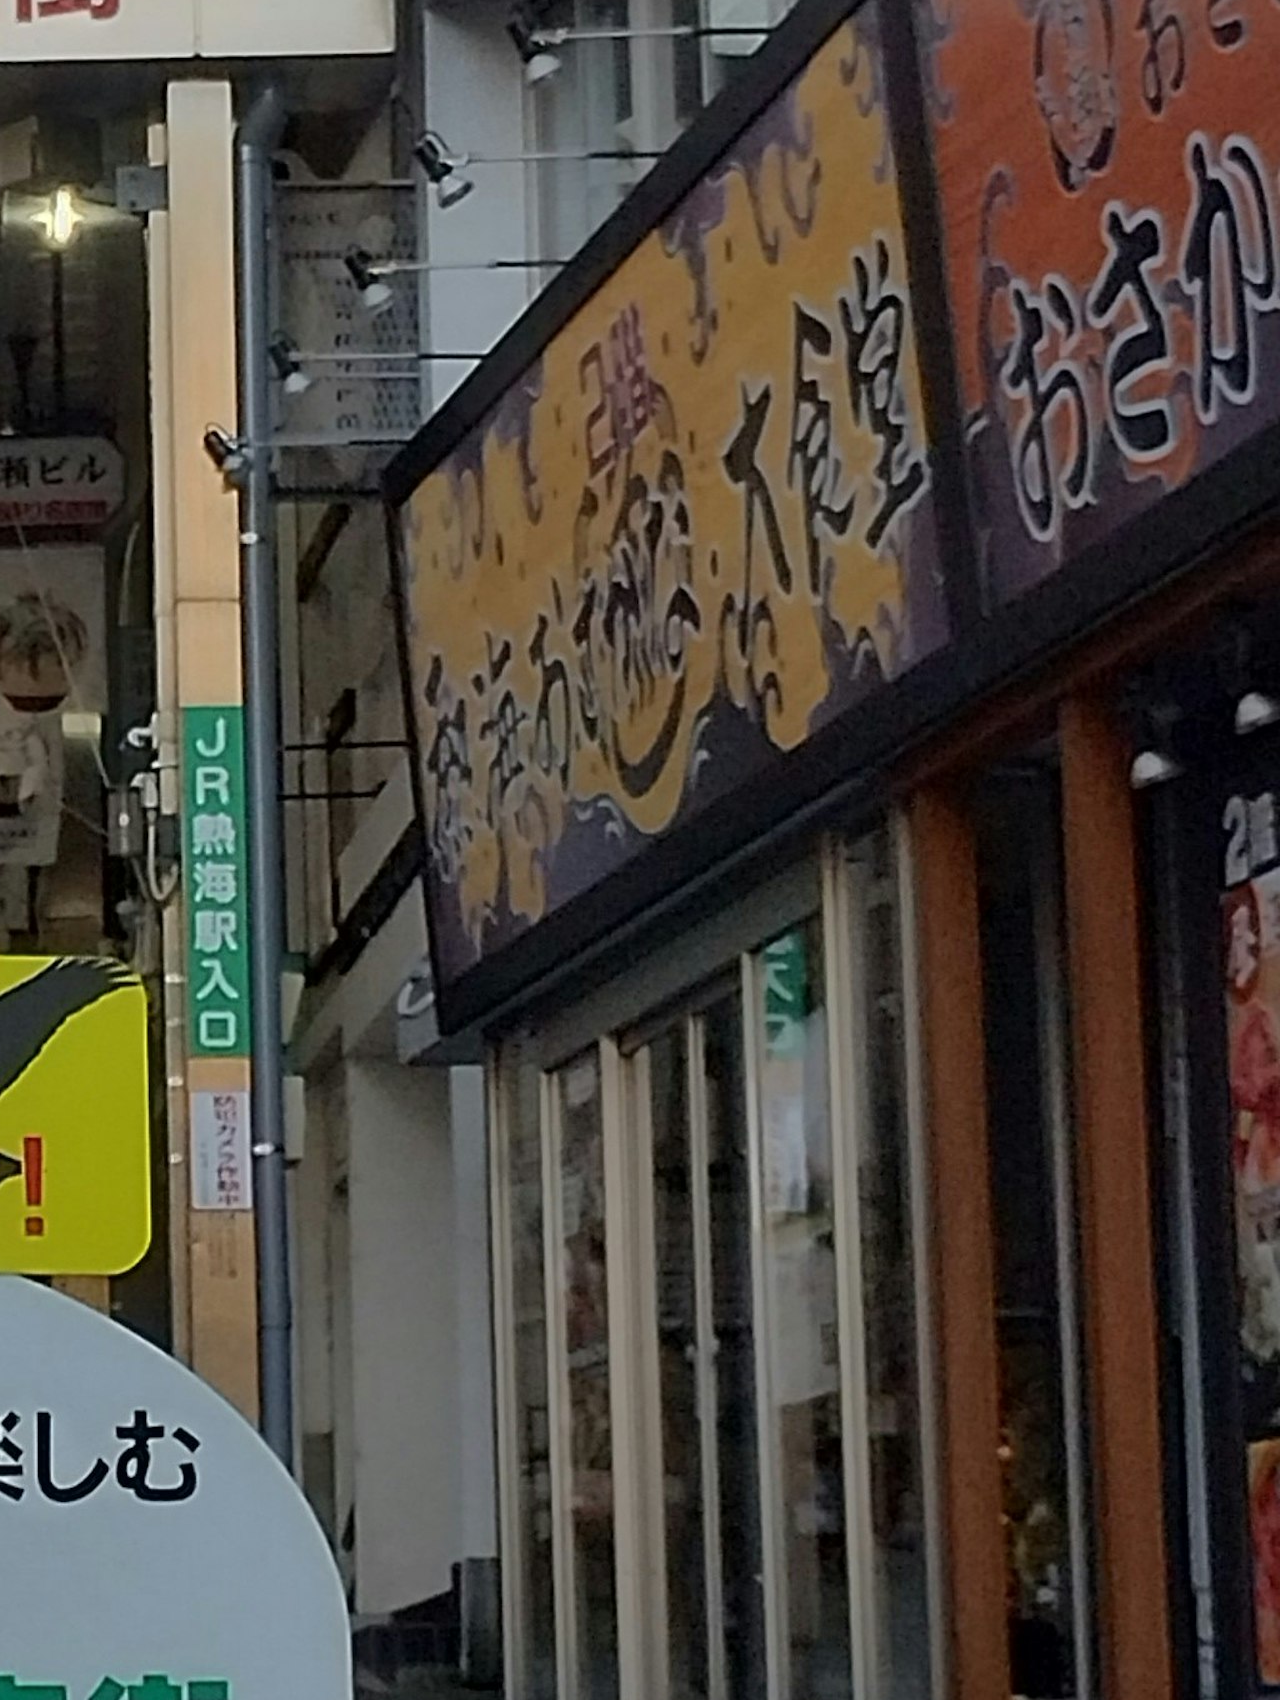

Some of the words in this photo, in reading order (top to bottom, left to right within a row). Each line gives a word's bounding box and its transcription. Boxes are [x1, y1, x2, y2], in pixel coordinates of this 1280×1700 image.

[193, 717, 239, 1048] JR熱海駅入口
